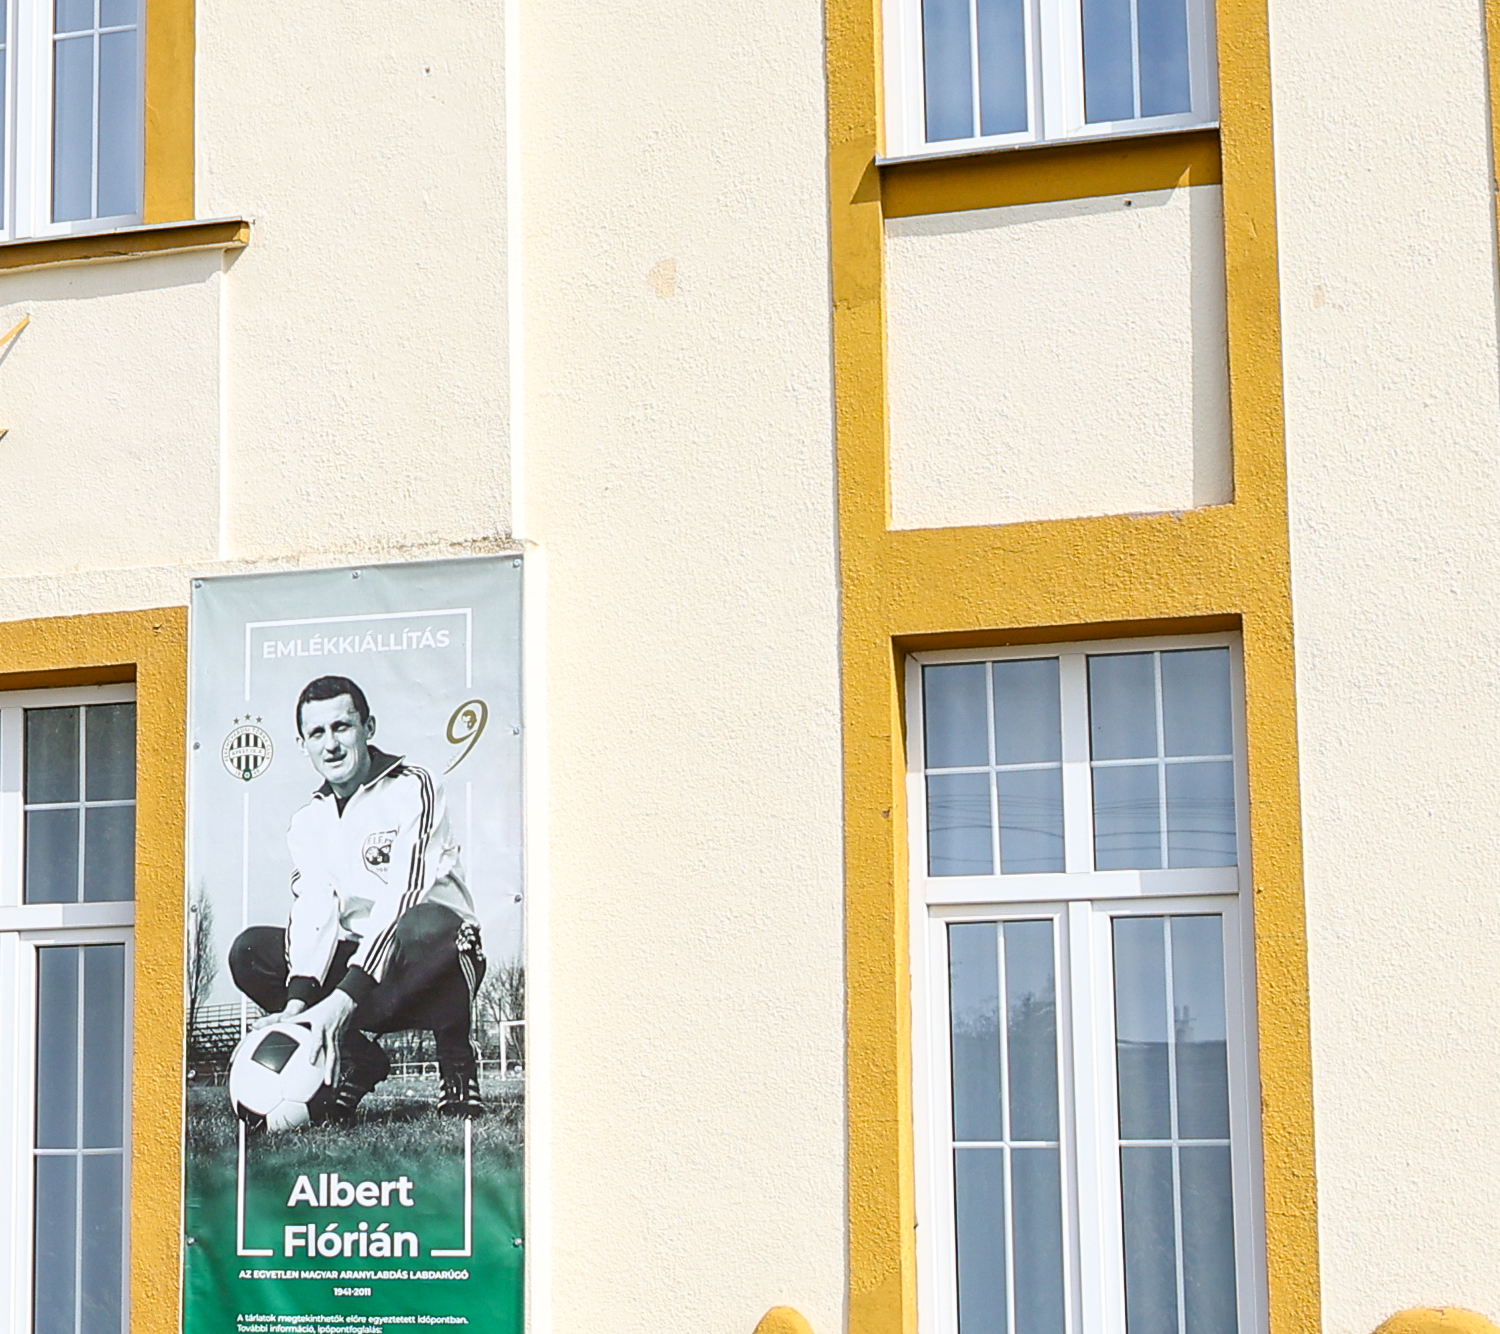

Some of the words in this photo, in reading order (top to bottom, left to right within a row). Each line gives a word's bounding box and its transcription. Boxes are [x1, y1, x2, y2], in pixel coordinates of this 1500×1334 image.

[263, 627, 450, 659] EMLÉKKIÁLLÍTÁS
[287, 1173, 415, 1207] Albert
[284, 1221, 418, 1257] Flórián
[239, 1270, 251, 1279] AZ
[253, 1270, 299, 1279] EGYETLEN
[301, 1270, 338, 1279] MAGYAR
[340, 1269, 408, 1279] ARANYLABDÁS
[410, 1269, 469, 1280] LABDARÚGÓ
[333, 1287, 372, 1296] 1941-2011
[237, 1314, 244, 1322] A
[245, 1313, 276, 1322] tárlatok
[368, 1316, 416, 1325] egyeztetett
[237, 1324, 268, 1333] További
[270, 1324, 316, 1334] információ,
